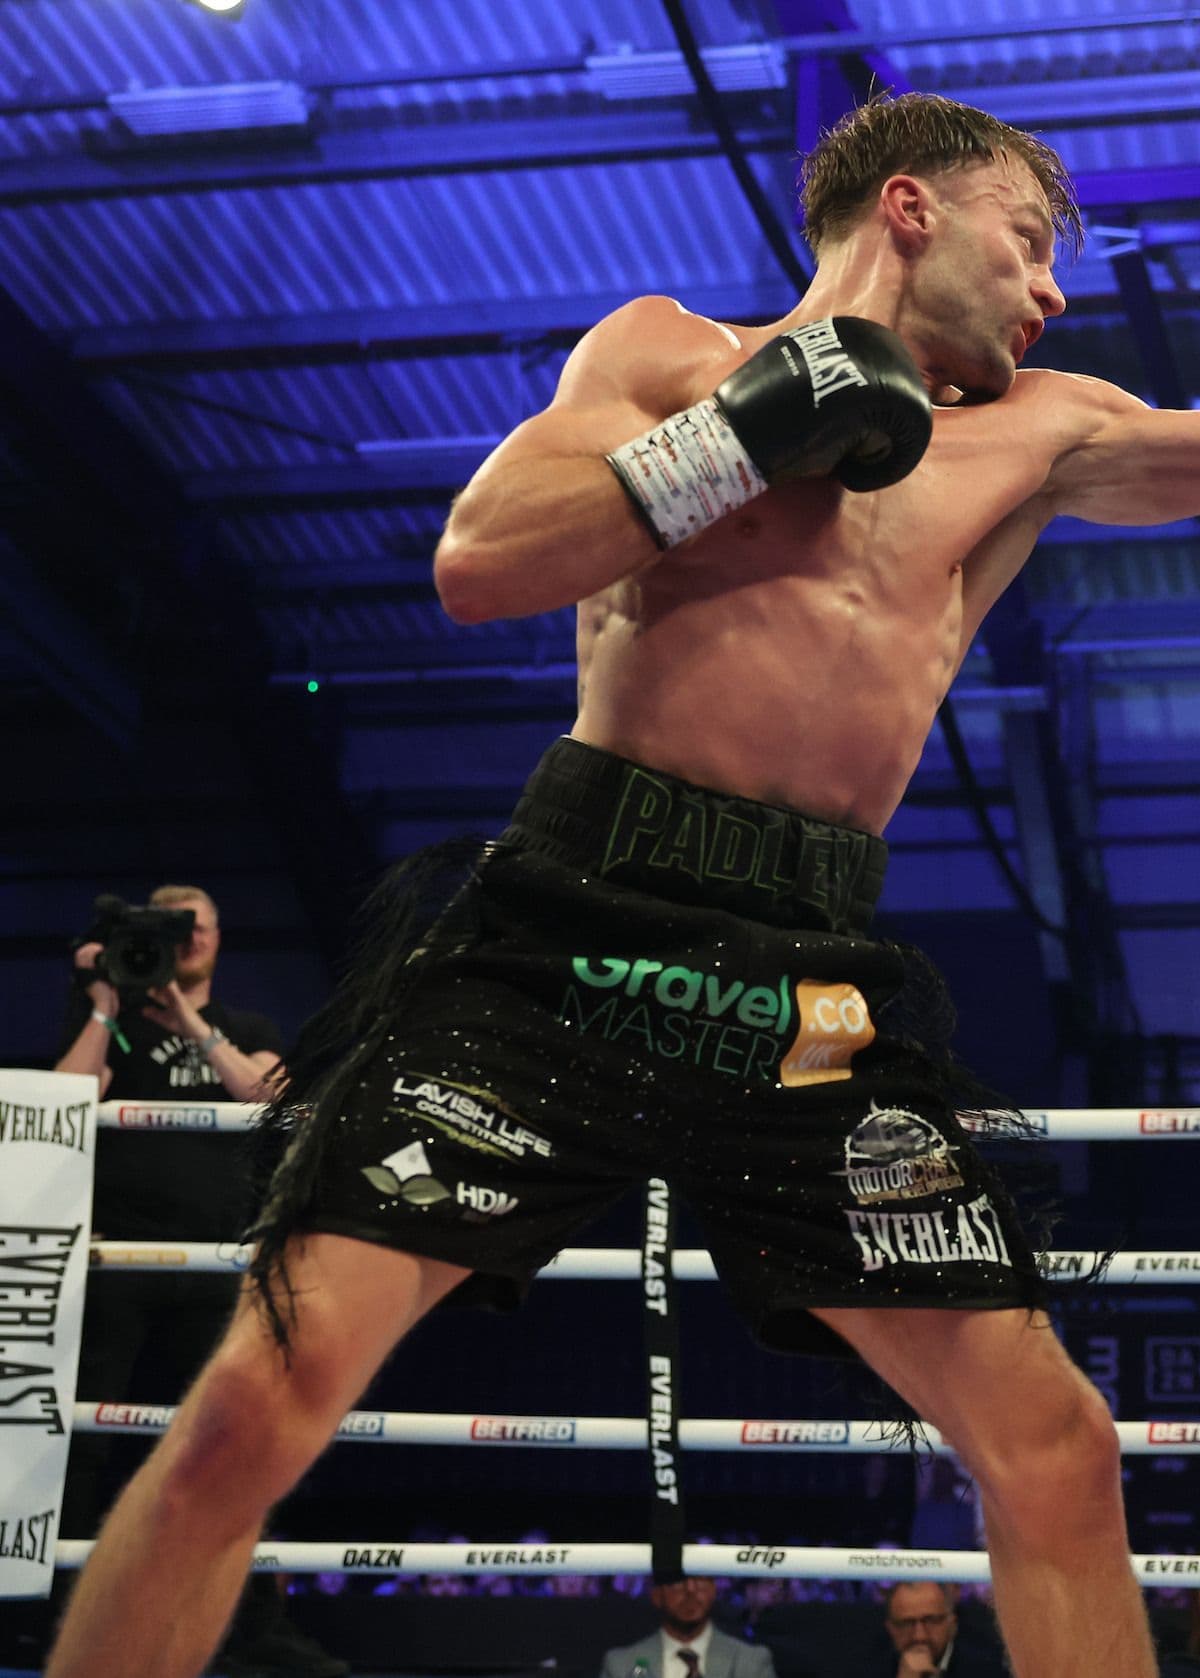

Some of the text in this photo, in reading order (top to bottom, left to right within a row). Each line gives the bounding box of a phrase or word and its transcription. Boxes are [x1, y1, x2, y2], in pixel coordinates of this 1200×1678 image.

[602, 768, 868, 929] PADLEY
[559, 984, 781, 1080] MASTER
[0, 1101, 91, 1152] VERLAST
[393, 1077, 553, 1158] LAVISH LIFE
[843, 1193, 1012, 1271] EVERLAST
[0, 1223, 83, 1435] EVERLAST
[473, 1418, 573, 1440] BETFRED
[649, 1355, 678, 1505] EVERLAST
[744, 1421, 848, 1443] BETFRED
[0, 1509, 55, 1565] LAST
[342, 1548, 571, 1568] DAZN EVERLAST
[736, 1545, 785, 1568] drip
